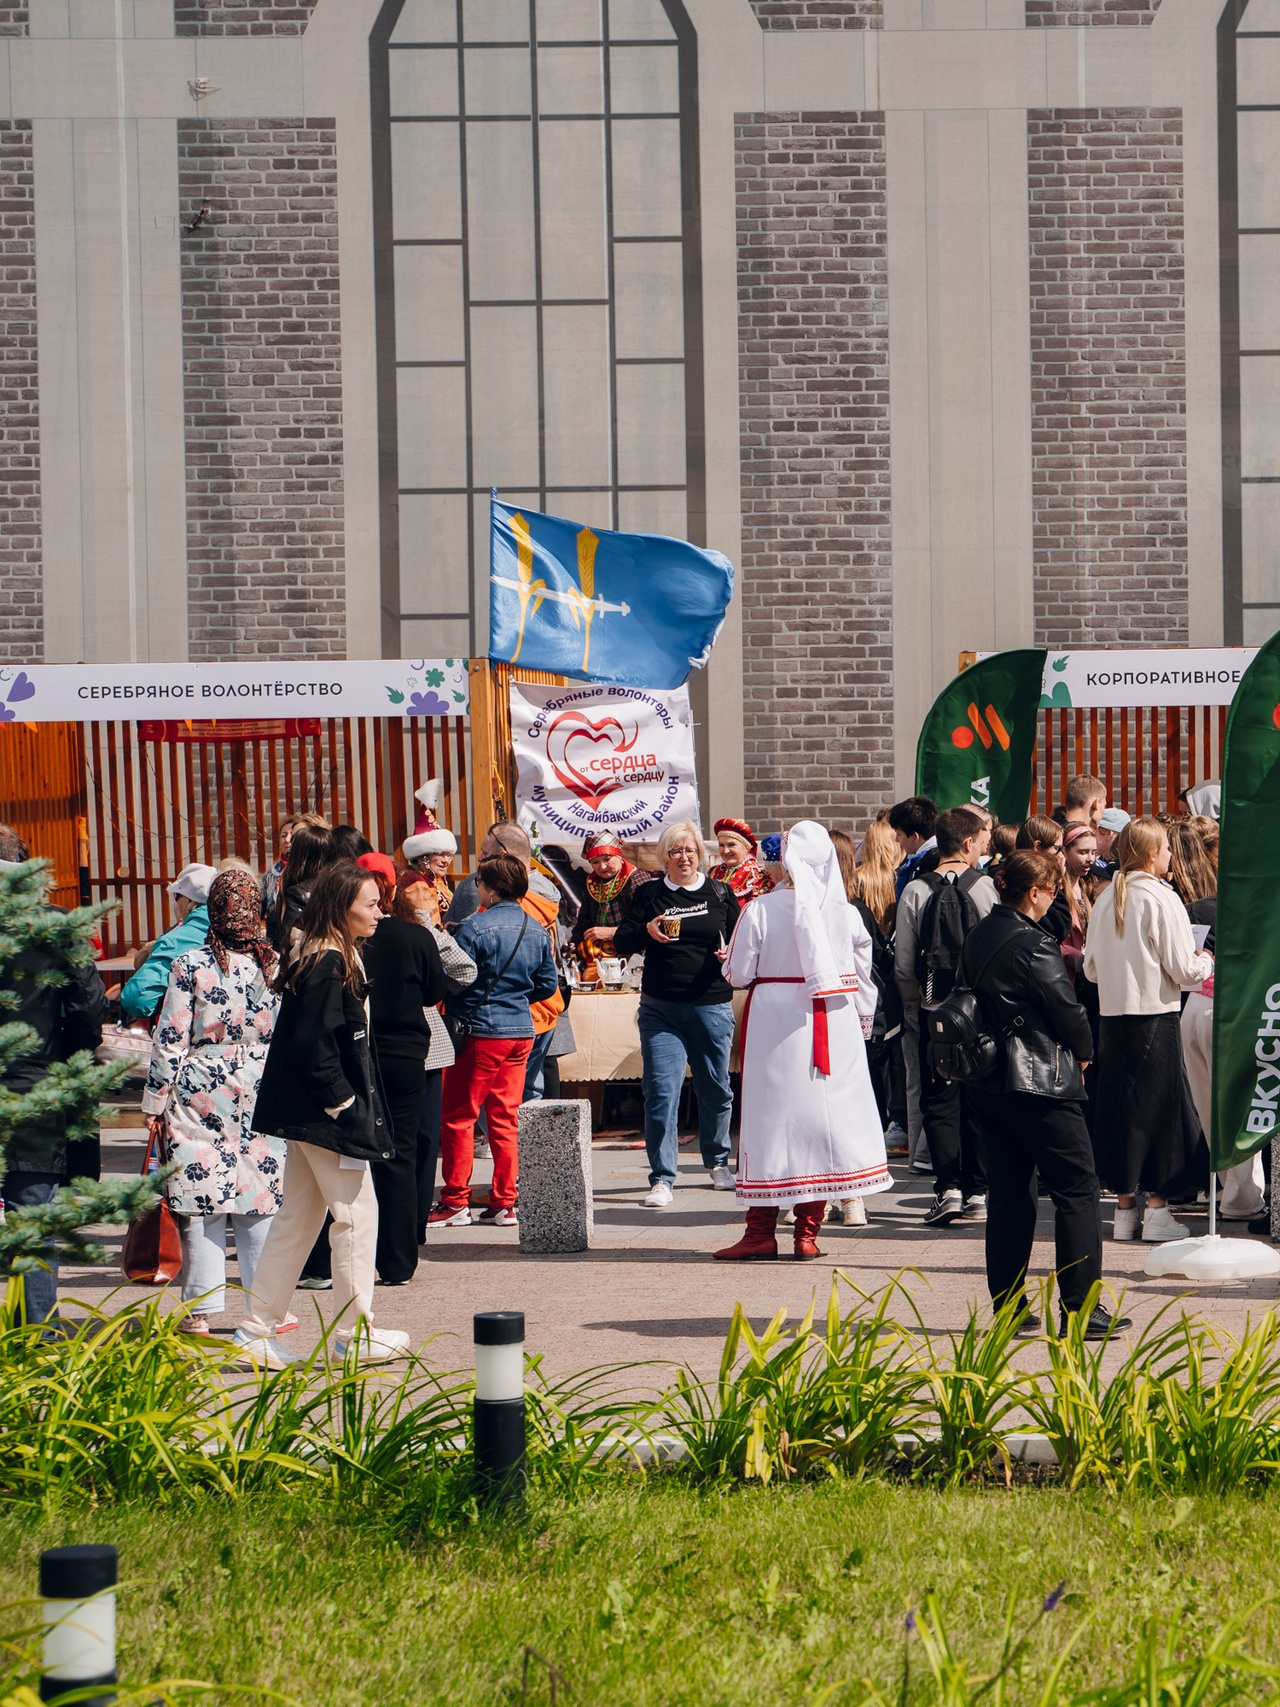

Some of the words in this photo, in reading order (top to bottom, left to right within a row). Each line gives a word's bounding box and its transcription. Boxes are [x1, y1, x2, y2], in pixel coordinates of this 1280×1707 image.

[1087, 670, 1241, 686] КОРПОРАТИВНОЕ
[77, 685, 195, 699] СЕРЕБРЯНОЕ
[201, 681, 343, 698] ВОЛОНТЁРСТВО
[528, 687, 604, 738] Серебряные
[608, 687, 674, 730] волонтеры
[589, 753, 657, 775] сердца
[615, 774, 621, 783] к
[624, 770, 665, 784] сердцу
[531, 785, 653, 839] муниципаный
[651, 775, 680, 823] район
[567, 799, 649, 824] Нагайбакский
